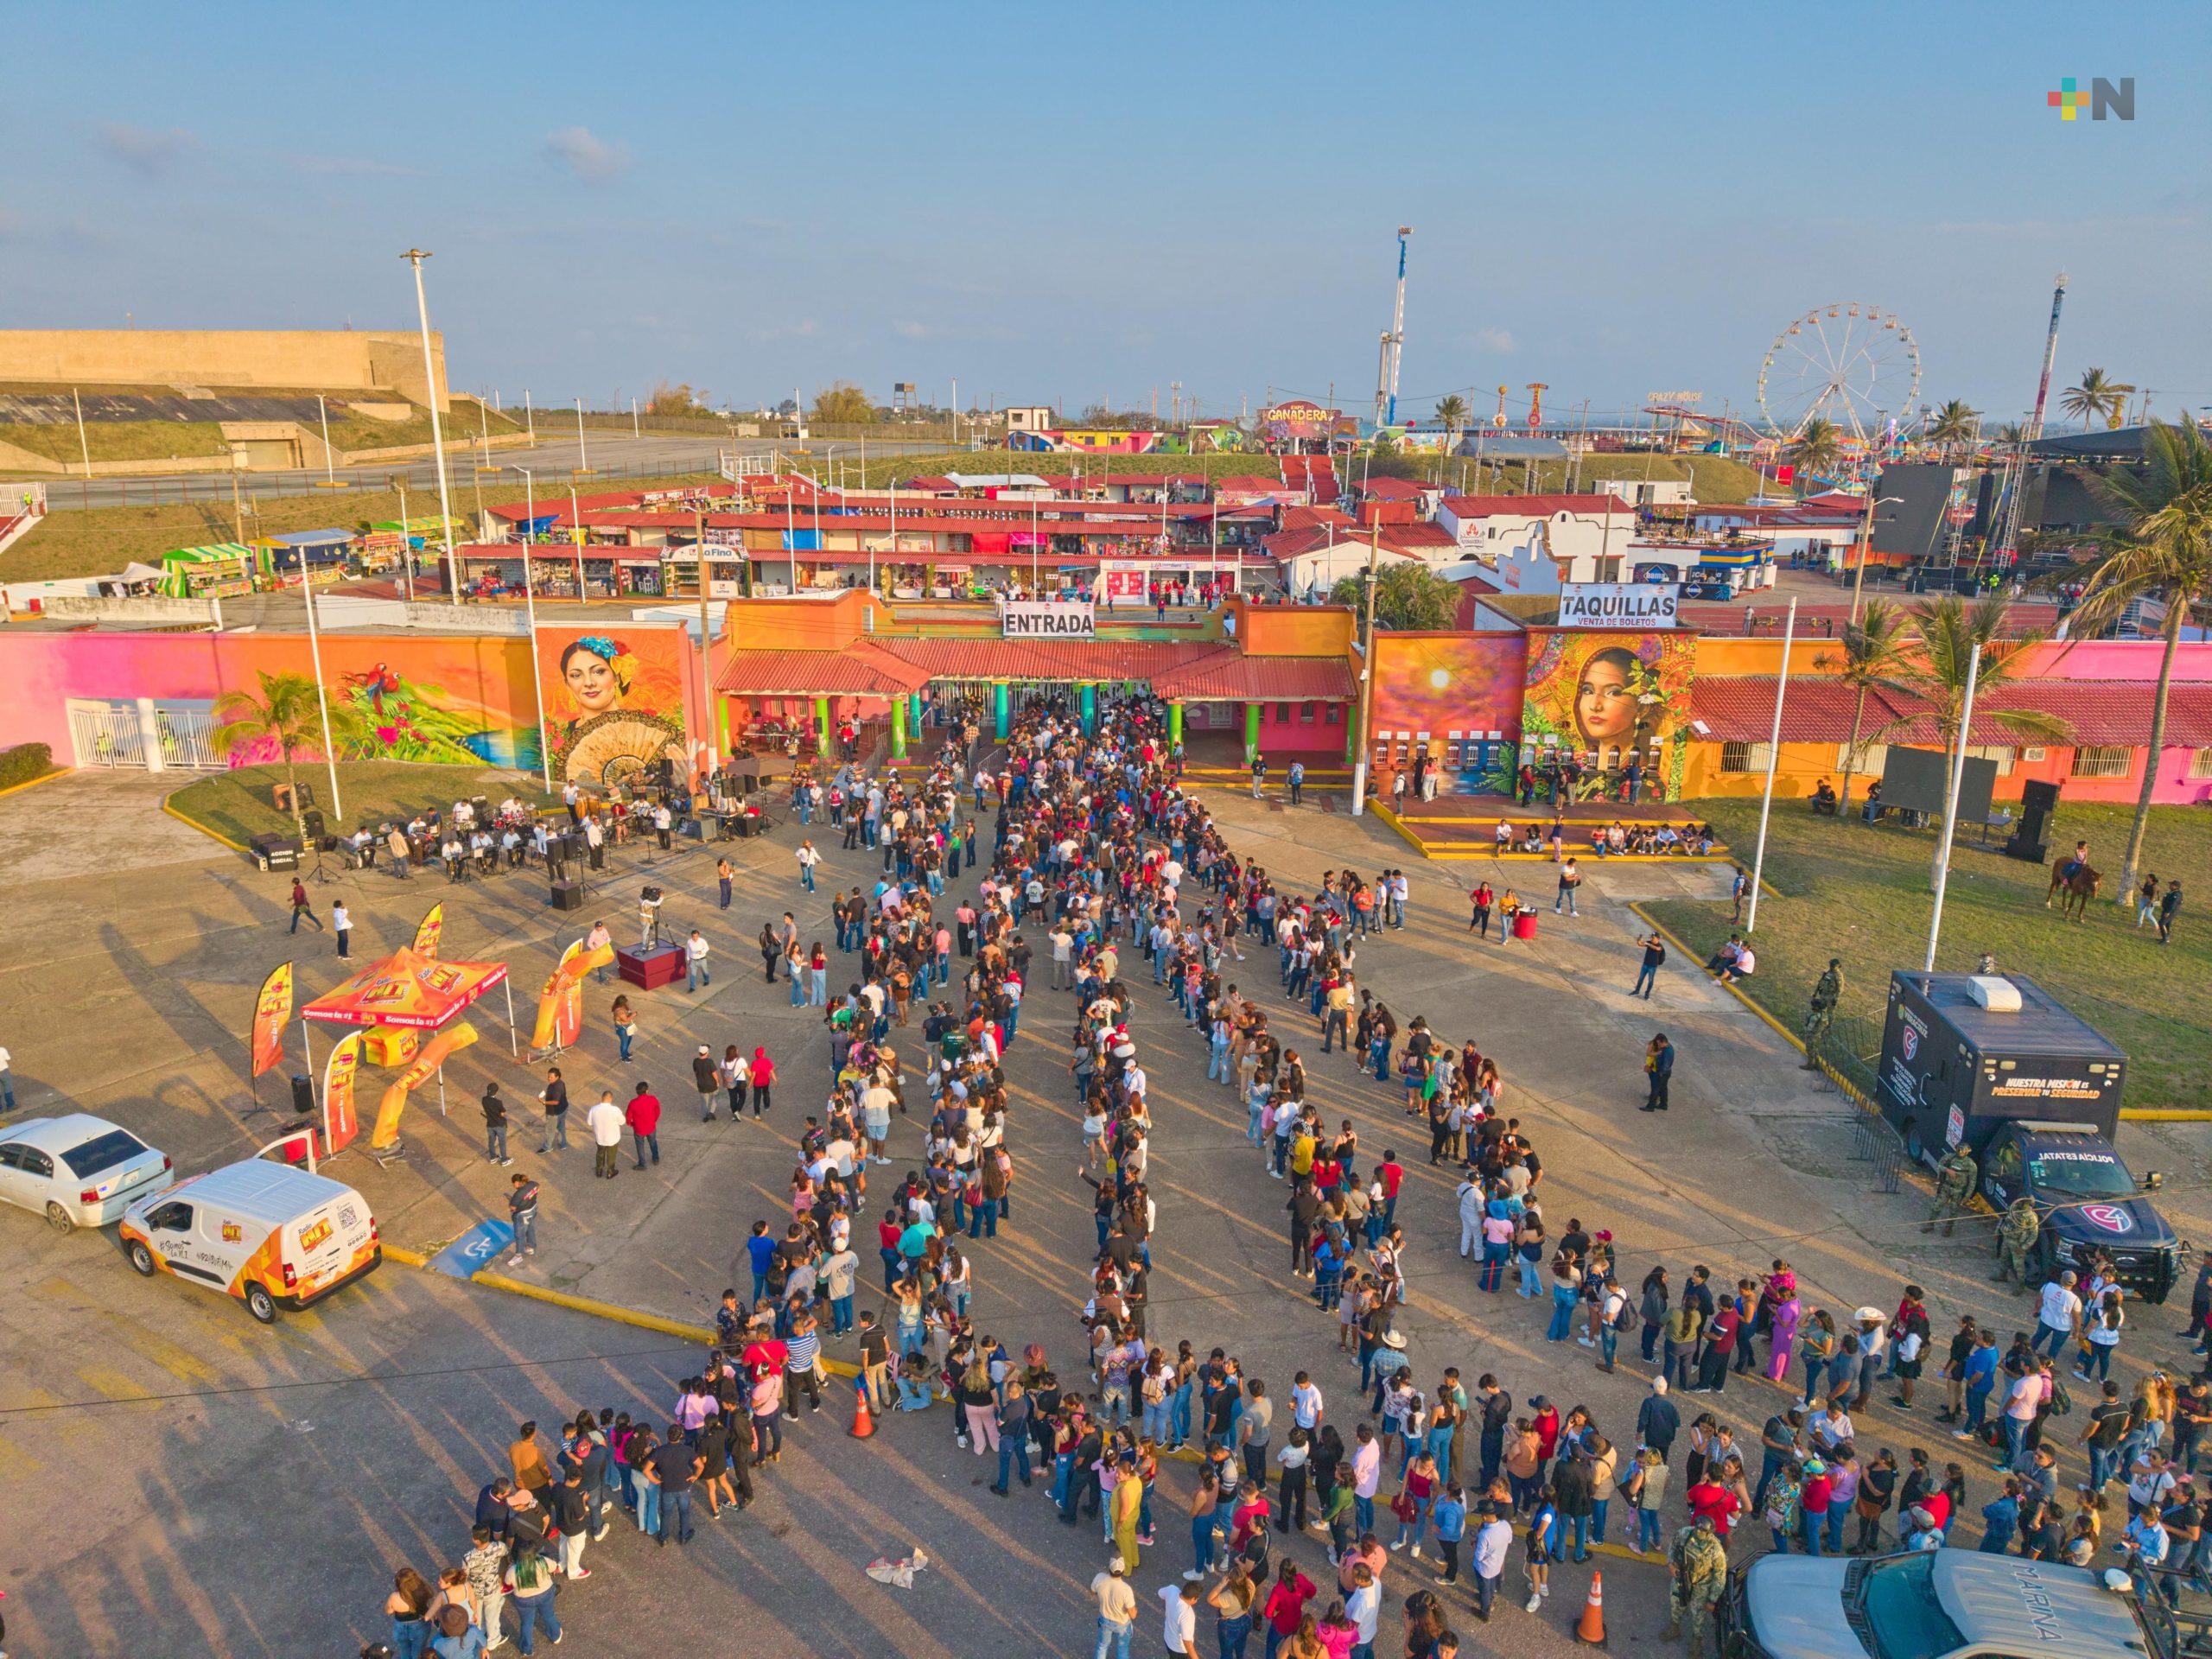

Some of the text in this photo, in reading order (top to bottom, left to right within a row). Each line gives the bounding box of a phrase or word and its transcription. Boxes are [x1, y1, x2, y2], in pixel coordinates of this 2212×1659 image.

[1649, 391, 1675, 402] CRAZY
[1268, 409, 1327, 421] GANADERA
[1562, 596, 1675, 616] TAQUILLAS
[1005, 613, 1093, 632] ENTRADA
[1578, 617, 1604, 626] VENTA
[1619, 618, 1656, 626] BOLETOS
[302, 1010, 333, 1019] Somos
[385, 1015, 416, 1025] Somos
[1904, 1010, 1928, 1038] VERACRUZ
[2005, 1077, 2046, 1088] NUESTRA
[1992, 1087, 2042, 1097] PRESERVAR
[2050, 1089, 2100, 1099] SEGURIDAD
[298, 1224, 312, 1234] Radio
[2011, 1562, 2064, 1641] MARINA
